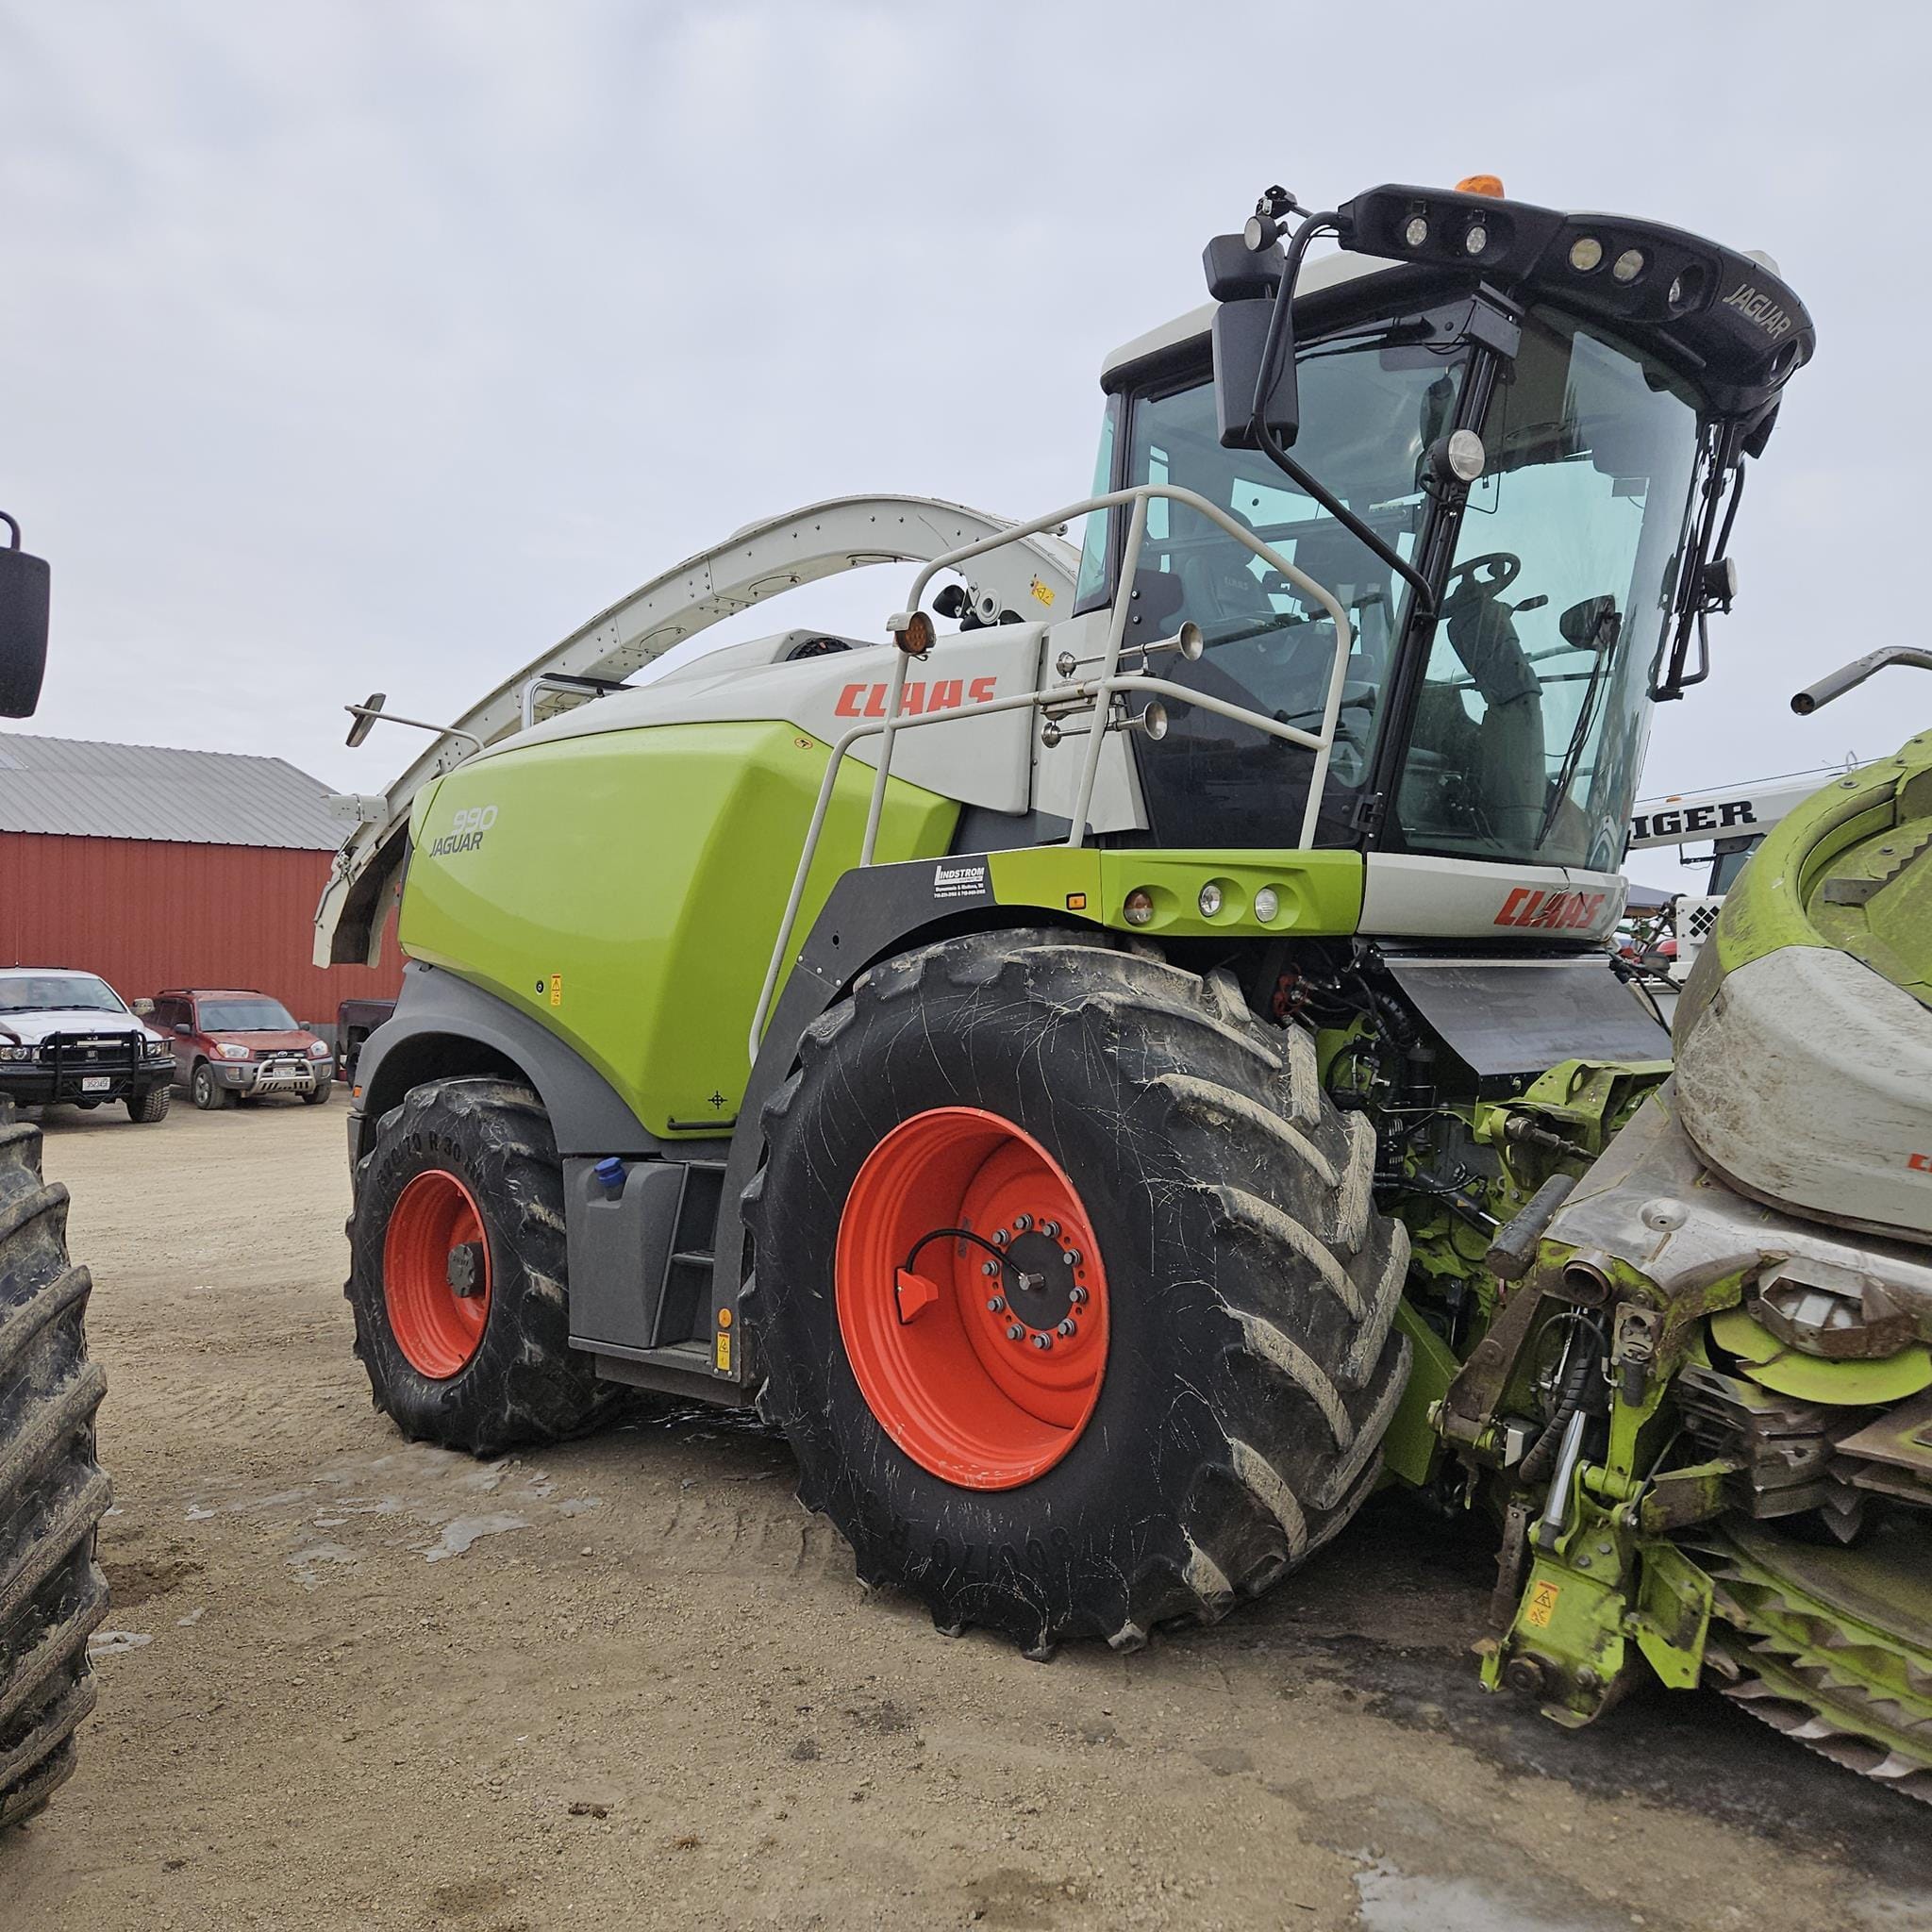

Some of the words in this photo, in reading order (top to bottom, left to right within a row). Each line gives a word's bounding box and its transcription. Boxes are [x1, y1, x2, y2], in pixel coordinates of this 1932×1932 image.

[1722, 283, 1791, 340] JAGUAR
[834, 676, 997, 718] CLAAS
[452, 805, 498, 837] 990
[429, 831, 483, 858] JAGUAR
[934, 865, 985, 886] LINDSTROM
[1493, 887, 1606, 929] CLAAS
